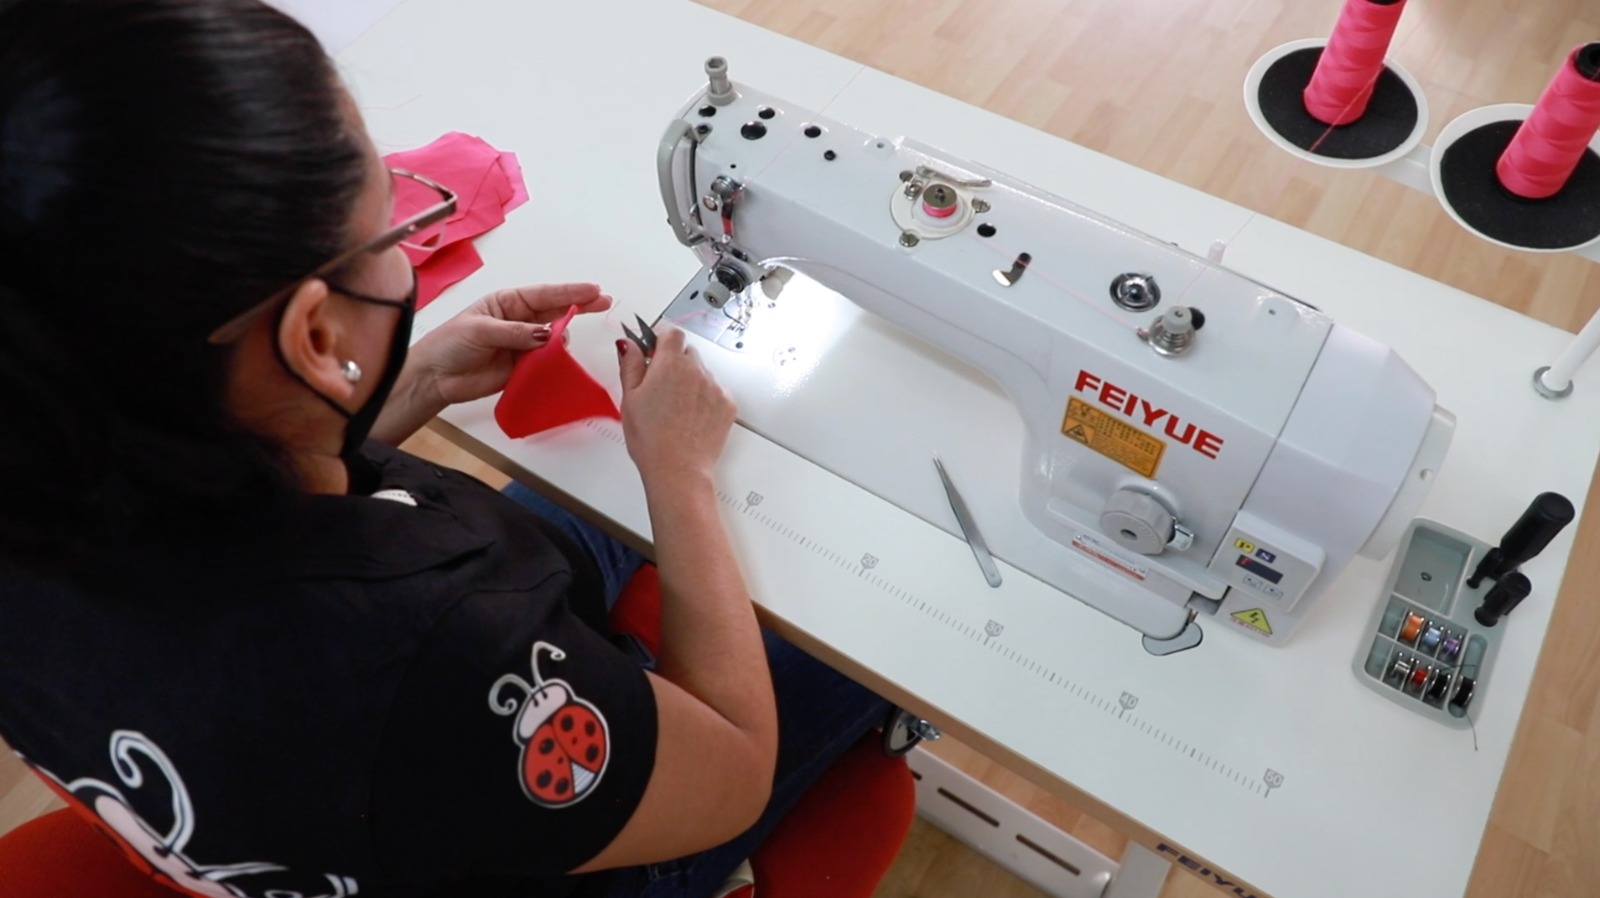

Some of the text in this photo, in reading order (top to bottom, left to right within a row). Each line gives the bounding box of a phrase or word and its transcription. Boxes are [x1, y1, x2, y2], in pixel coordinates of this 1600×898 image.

[1075, 370, 1224, 459] FEIYUE
[748, 492, 762, 505] 10
[862, 554, 877, 568] 20
[986, 621, 1002, 635] 30
[1120, 694, 1137, 708] 40
[1265, 771, 1282, 786] 50
